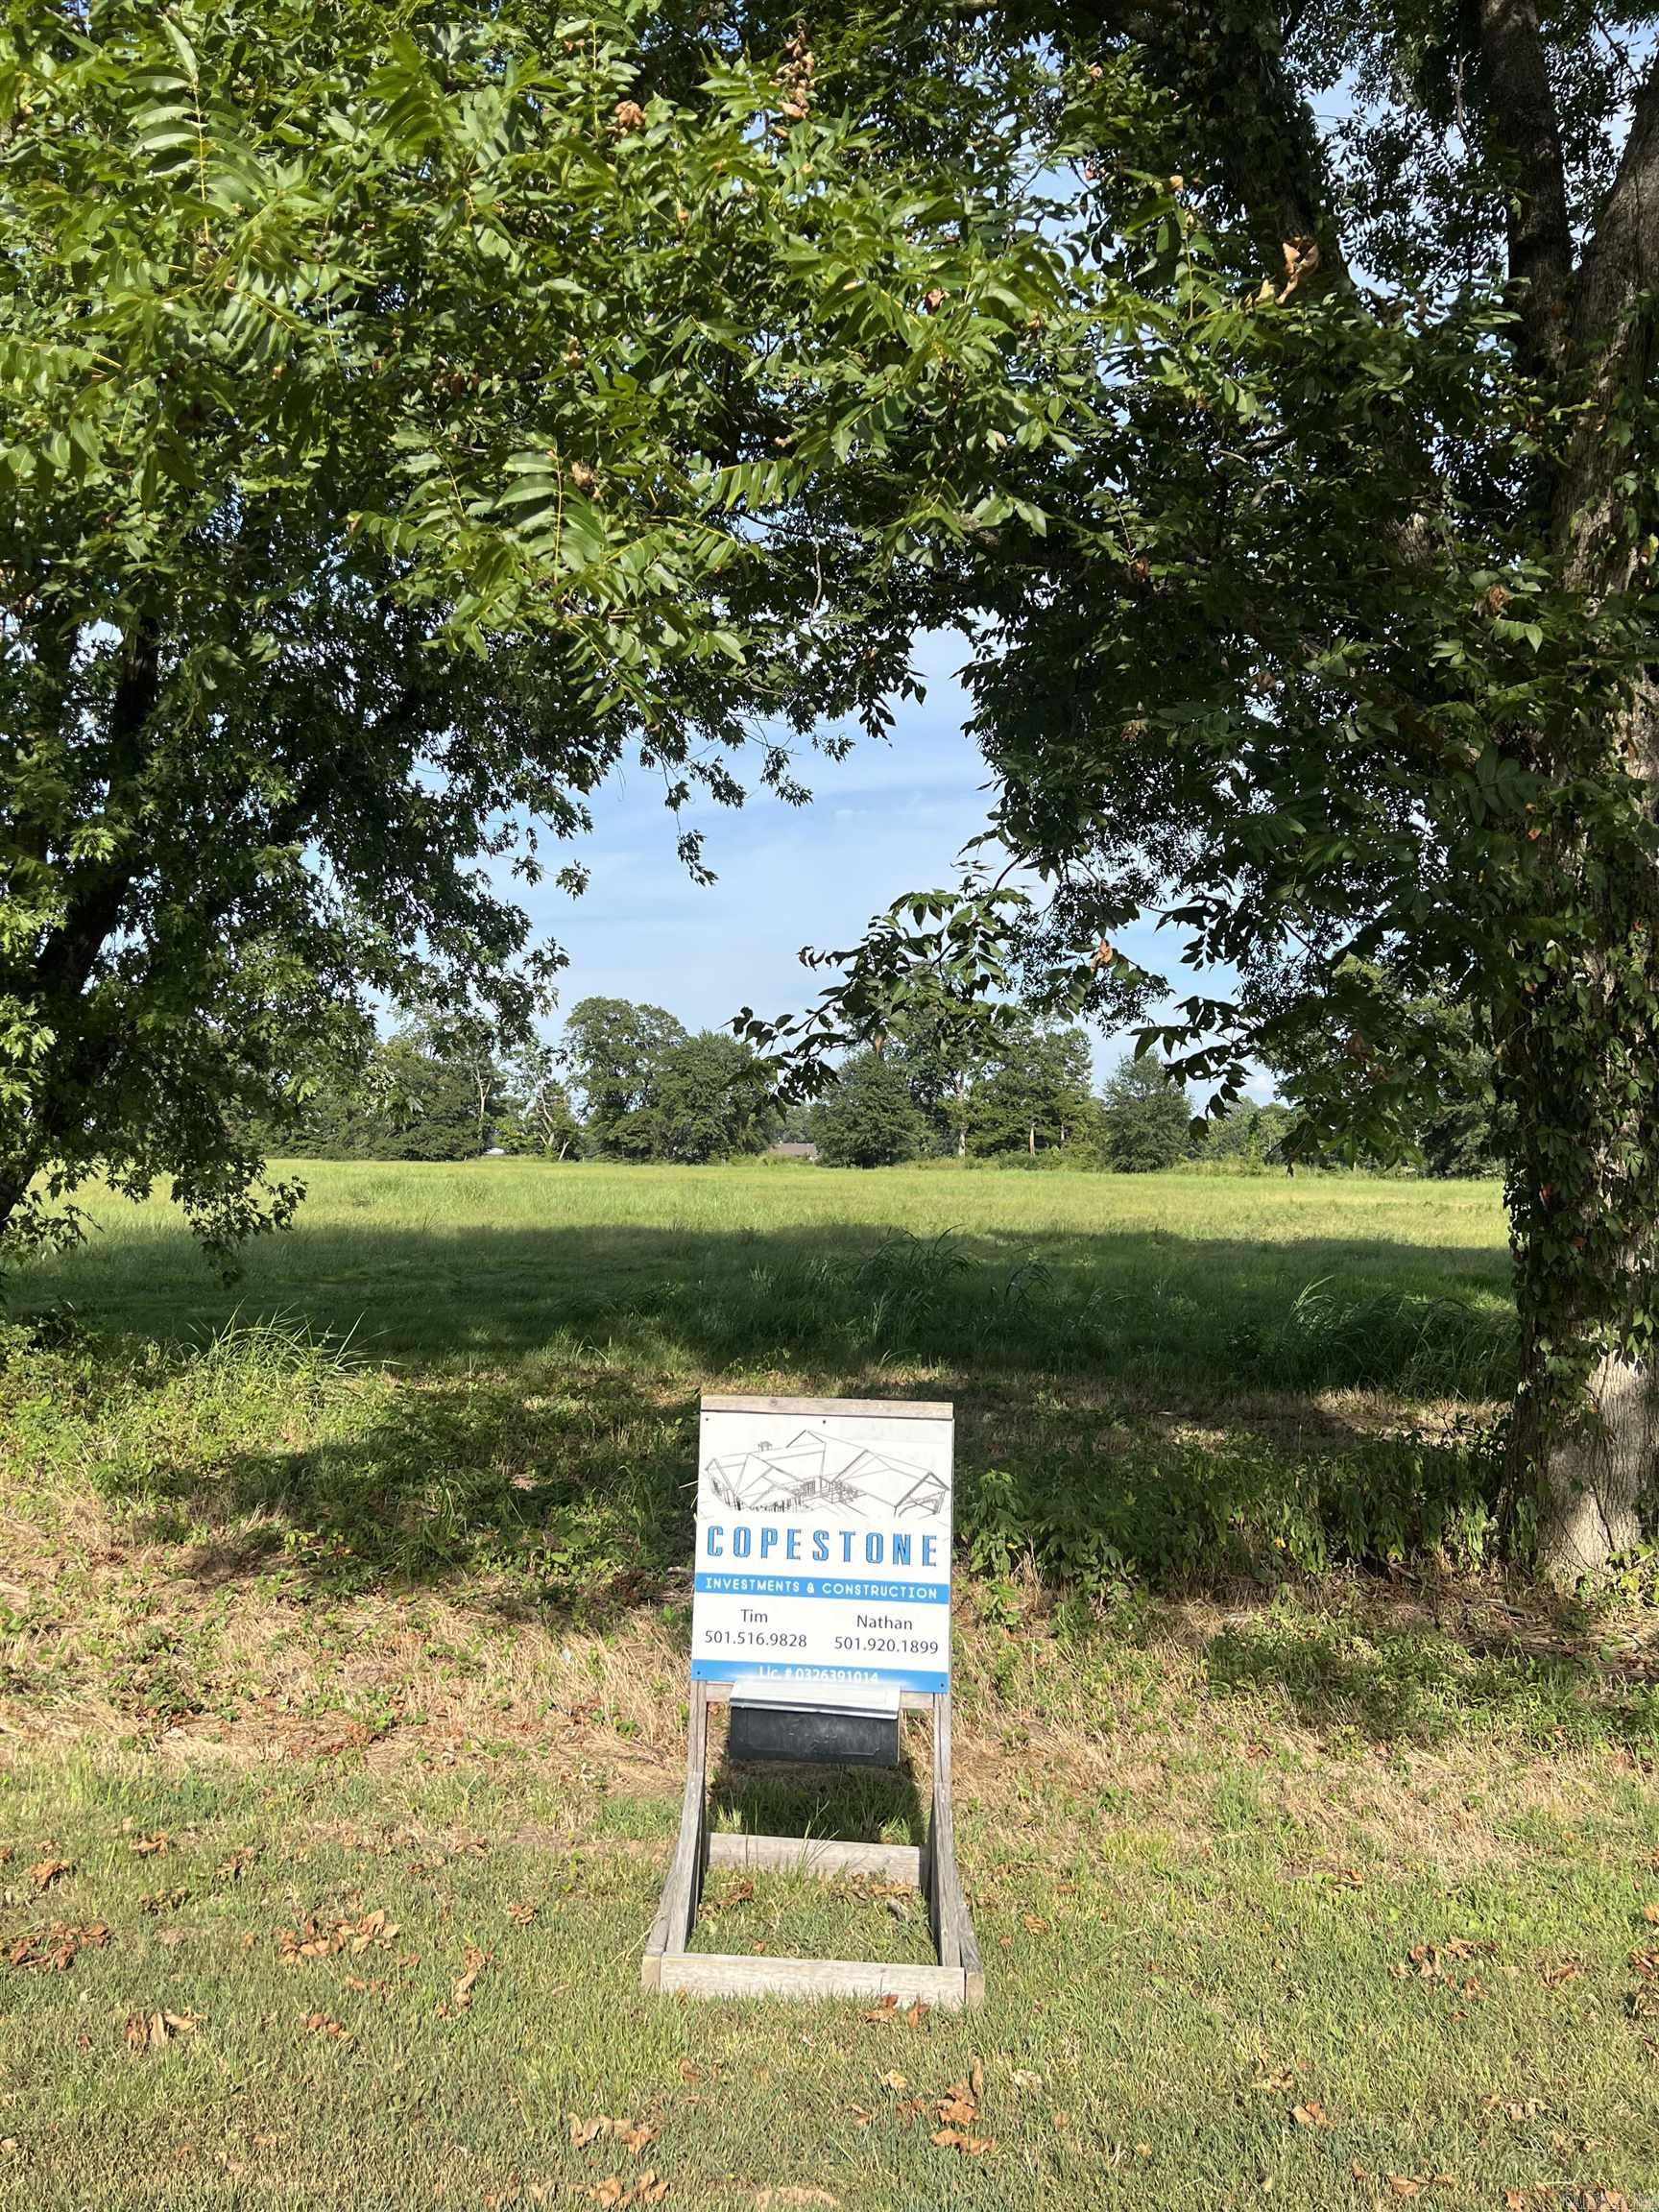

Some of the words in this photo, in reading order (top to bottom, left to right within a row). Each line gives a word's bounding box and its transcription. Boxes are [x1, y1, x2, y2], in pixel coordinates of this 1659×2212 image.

[707, 1526, 937, 1567] COPESTONE
[706, 1576, 800, 1593] INVESTMENTS
[806, 1581, 814, 1594] &
[822, 1582, 938, 1599] CONSTRUCTION
[740, 1609, 768, 1623] Tim
[856, 1614, 913, 1631] Nathan
[704, 1630, 807, 1647] 501.516.9828
[833, 1636, 939, 1654] 501.920.1899
